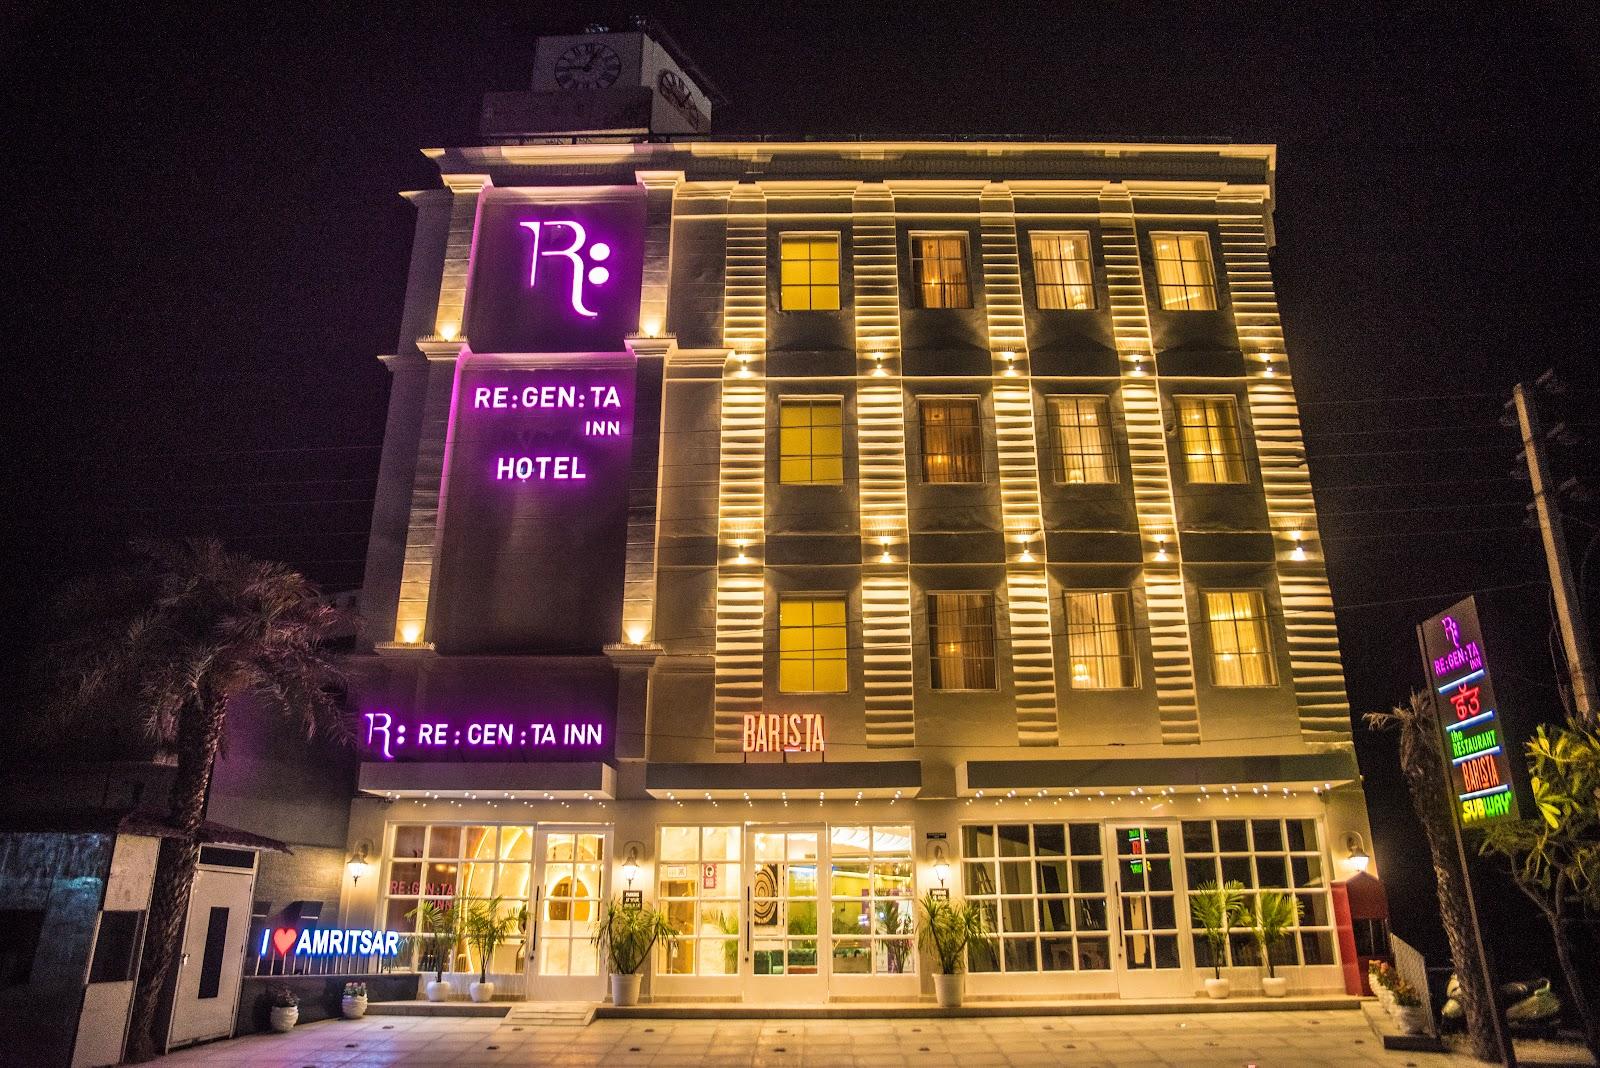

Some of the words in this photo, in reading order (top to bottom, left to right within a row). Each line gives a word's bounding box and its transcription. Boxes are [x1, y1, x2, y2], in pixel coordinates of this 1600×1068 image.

[585, 421, 620, 436] INN
[497, 457, 587, 480] HOTEL
[1470, 657, 1481, 672] INN
[563, 723, 603, 745] INN
[742, 713, 825, 753] BARISTA
[1451, 730, 1463, 743] the
[1454, 730, 1497, 757] RESTAURANT
[1462, 755, 1499, 791] BARISTA
[1463, 791, 1512, 821] SUBWAY
[260, 928, 271, 957] I
[295, 928, 399, 957] AMRITSAR
